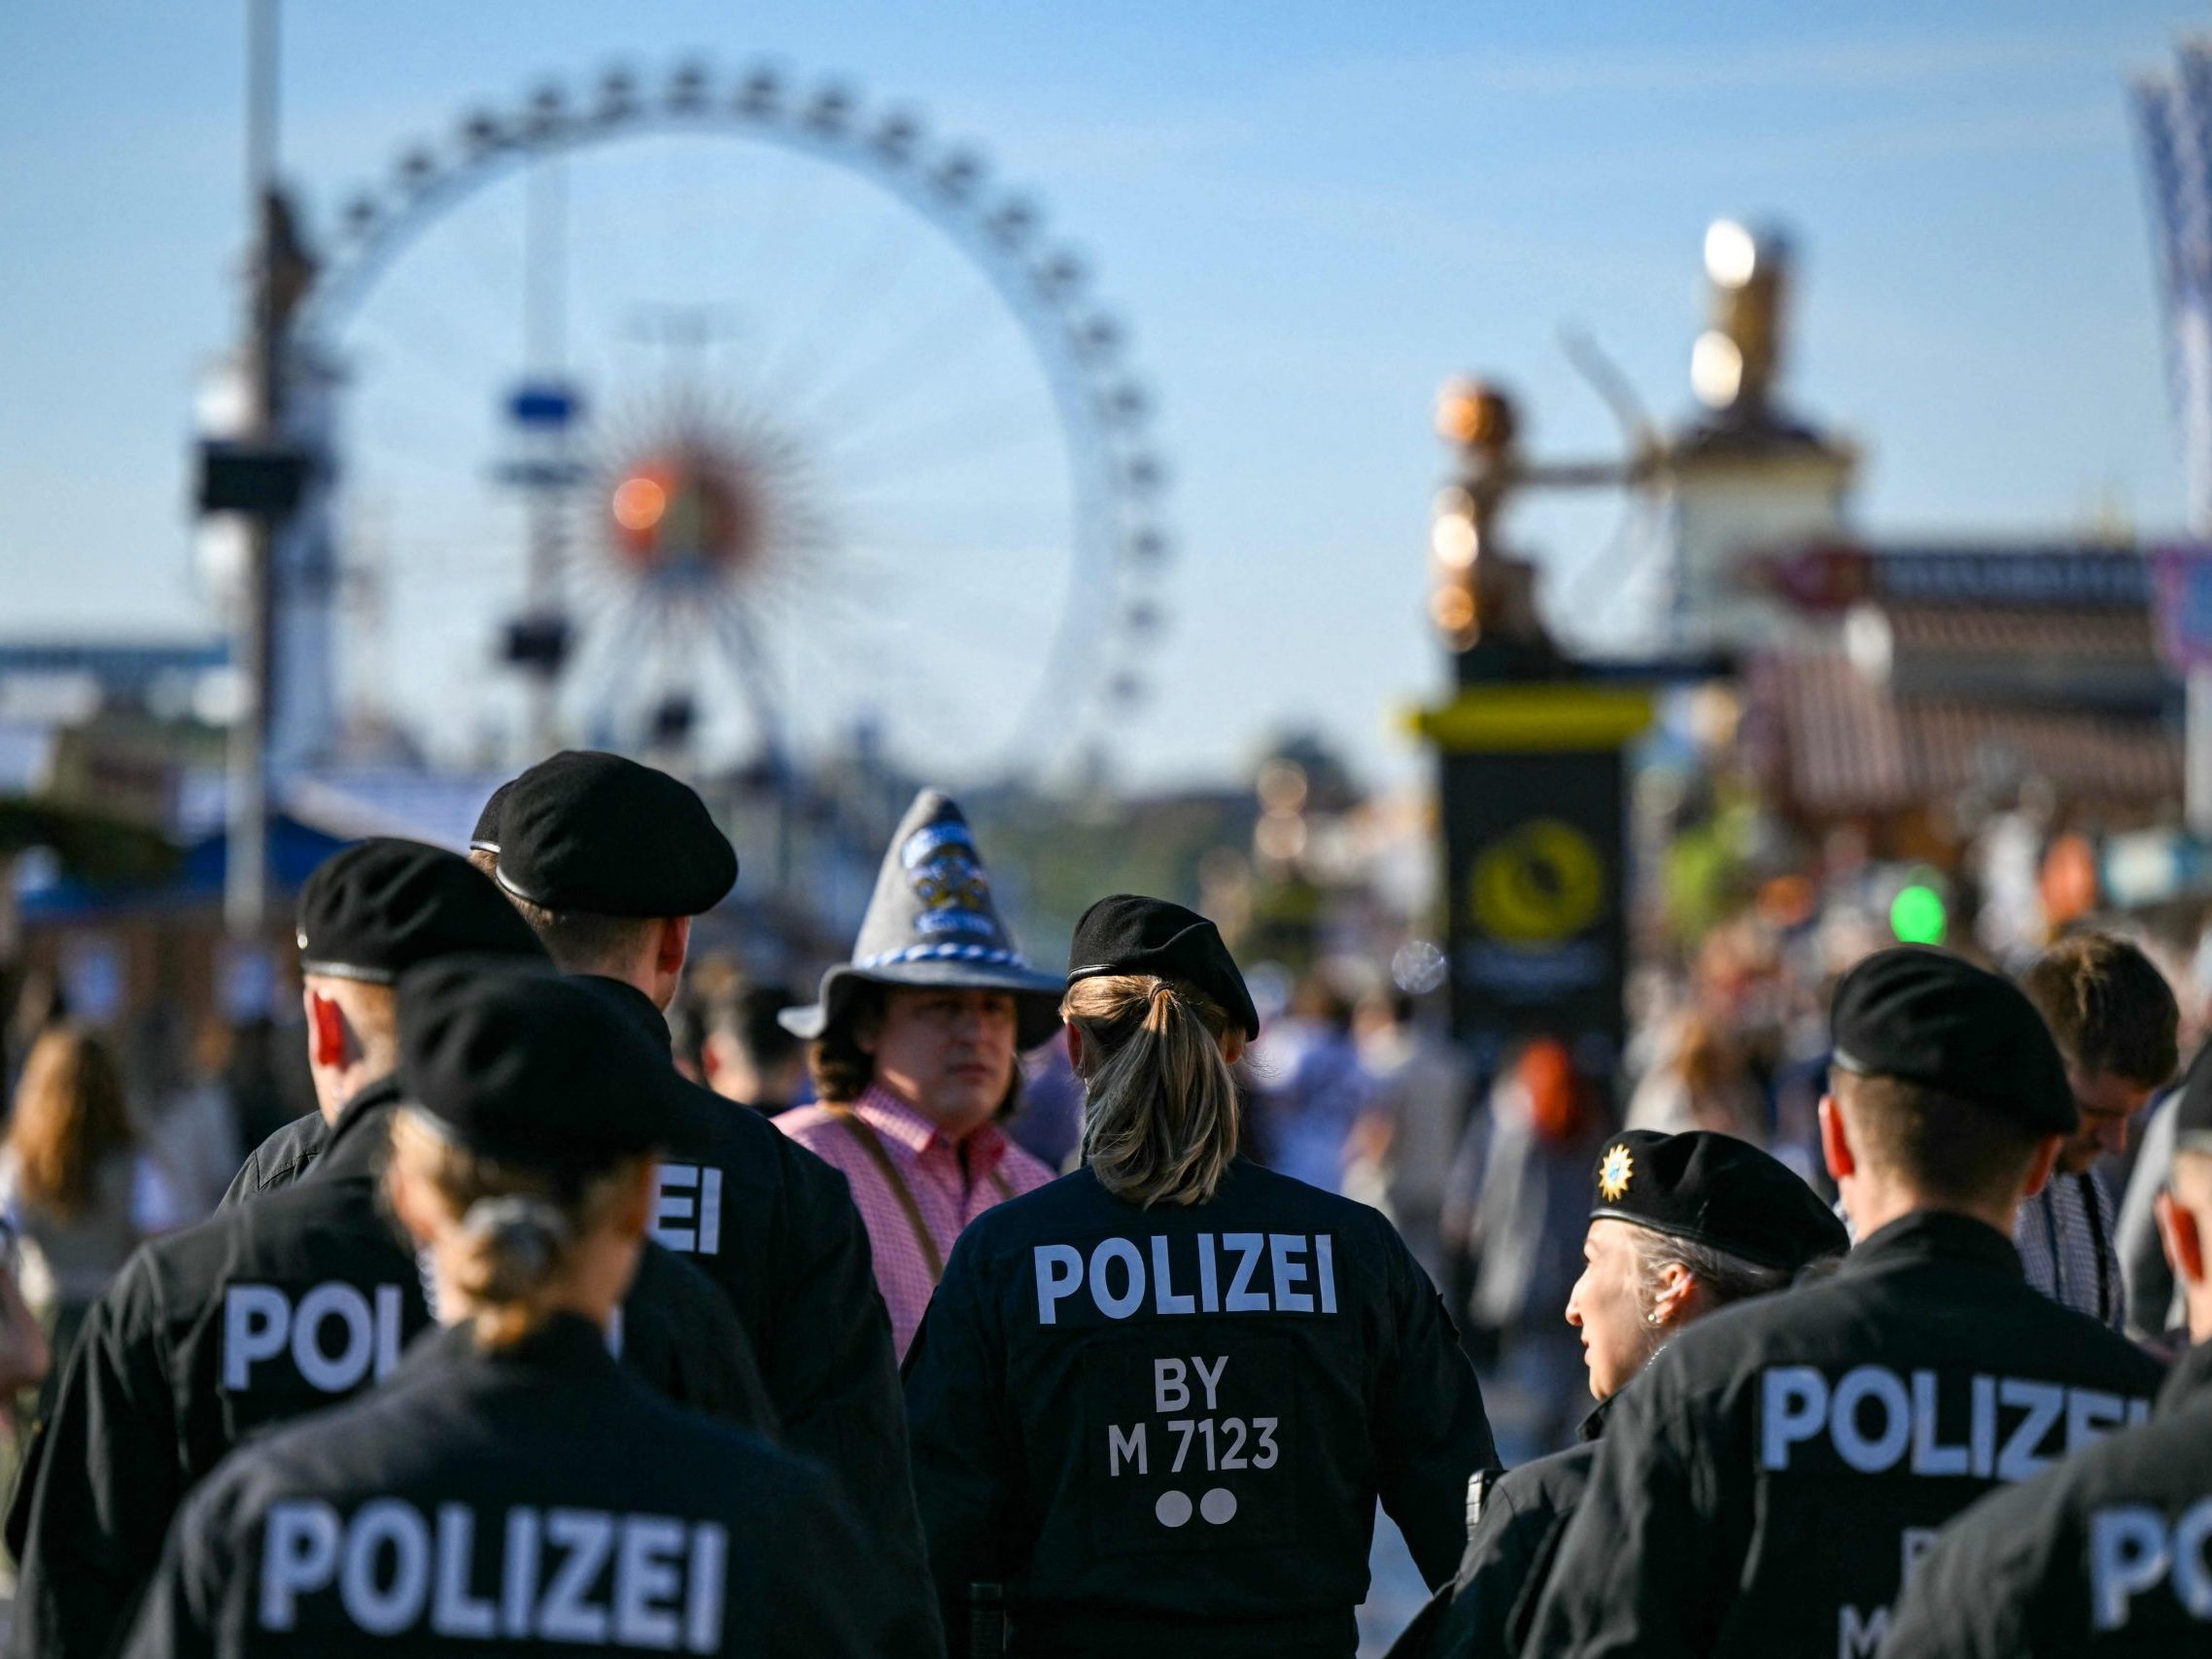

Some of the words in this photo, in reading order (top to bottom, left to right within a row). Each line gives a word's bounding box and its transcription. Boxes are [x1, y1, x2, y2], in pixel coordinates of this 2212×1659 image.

[1033, 1233, 1337, 1325] POLIZEI
[1154, 1356, 1228, 1413] BY
[1761, 1364, 2150, 1483] POLIZE
[1108, 1423, 1148, 1476] M
[1167, 1417, 1279, 1472] 7123
[259, 1499, 729, 1656] POLIZEI
